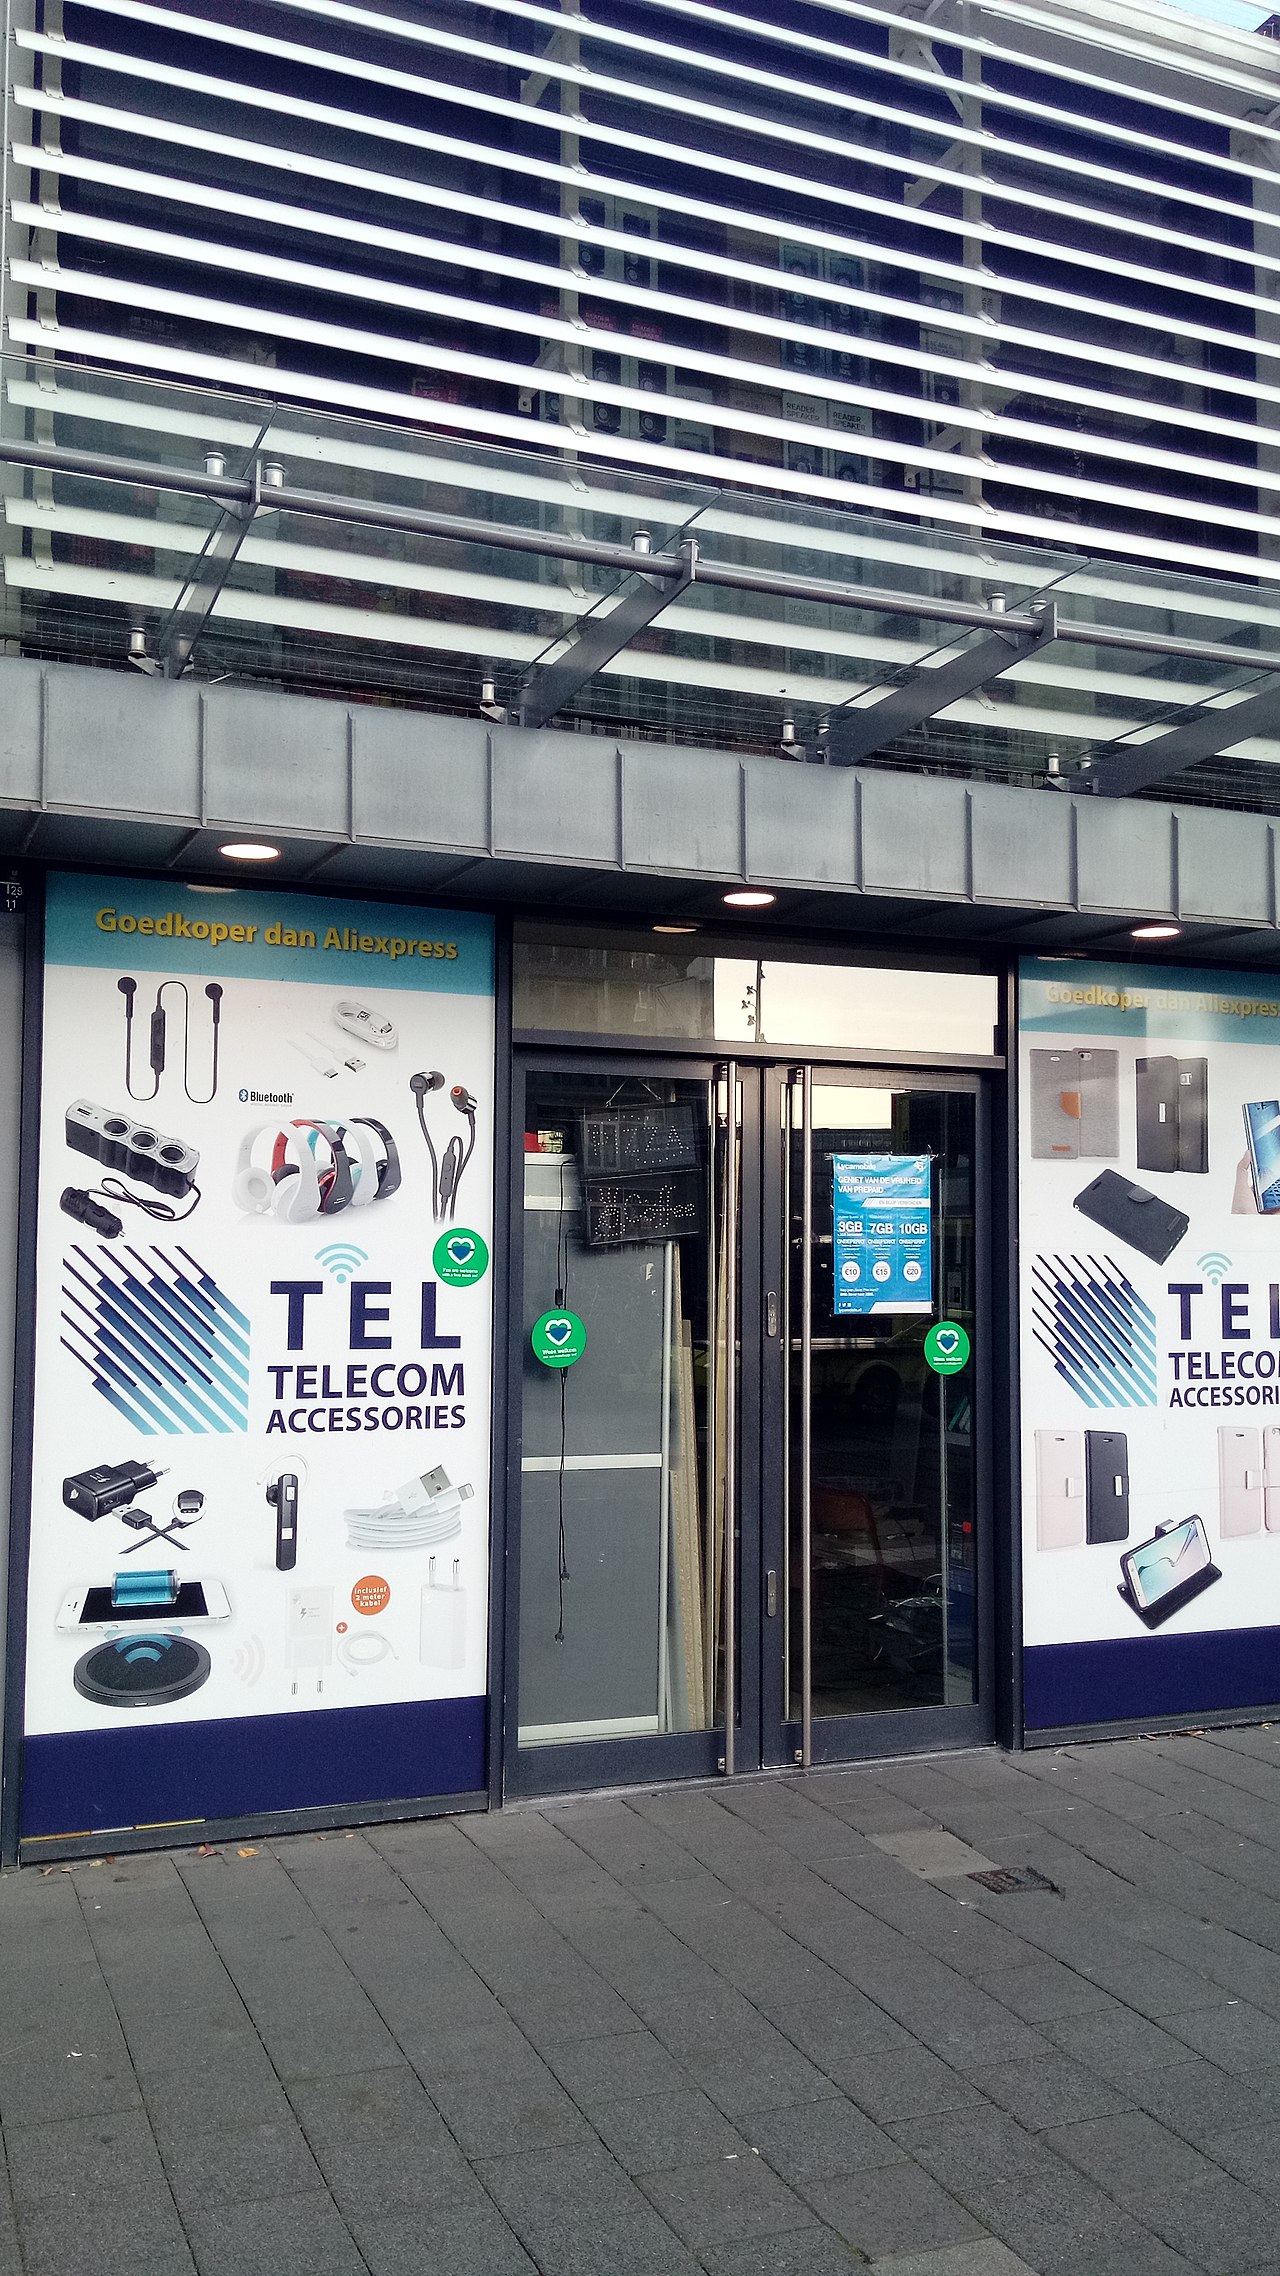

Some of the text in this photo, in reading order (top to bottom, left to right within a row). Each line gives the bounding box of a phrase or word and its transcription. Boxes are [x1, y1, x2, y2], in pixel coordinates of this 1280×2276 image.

[786, 402, 816, 413] READER
[786, 409, 821, 422] SPEAKER
[832, 411, 862, 423] READER
[832, 418, 866, 431] SPEAKER
[95, 907, 458, 960] Goedkoper dan Aliexpress
[1045, 982, 1280, 1019] Goedkoper dan Aliexpres
[592, 1125, 684, 1156] PIZZA
[837, 1161, 877, 1171] Lycamobile
[838, 1176, 864, 1184] GENIET
[880, 1177, 890, 1185] DE
[891, 1177, 922, 1185] VRIJHEID
[854, 1186, 884, 1194] PREPAID
[838, 1221, 863, 1233] 3GB
[869, 1222, 894, 1235] 7GB
[899, 1223, 928, 1235] 10GB
[844, 1268, 858, 1276] €10
[875, 1268, 888, 1276] €15
[906, 1268, 919, 1276] €20
[270, 1281, 461, 1351] TEL
[1168, 1351, 1280, 1380] TELECO
[267, 1363, 465, 1400] TELECOM
[265, 1405, 466, 1434] ACCESSORIES
